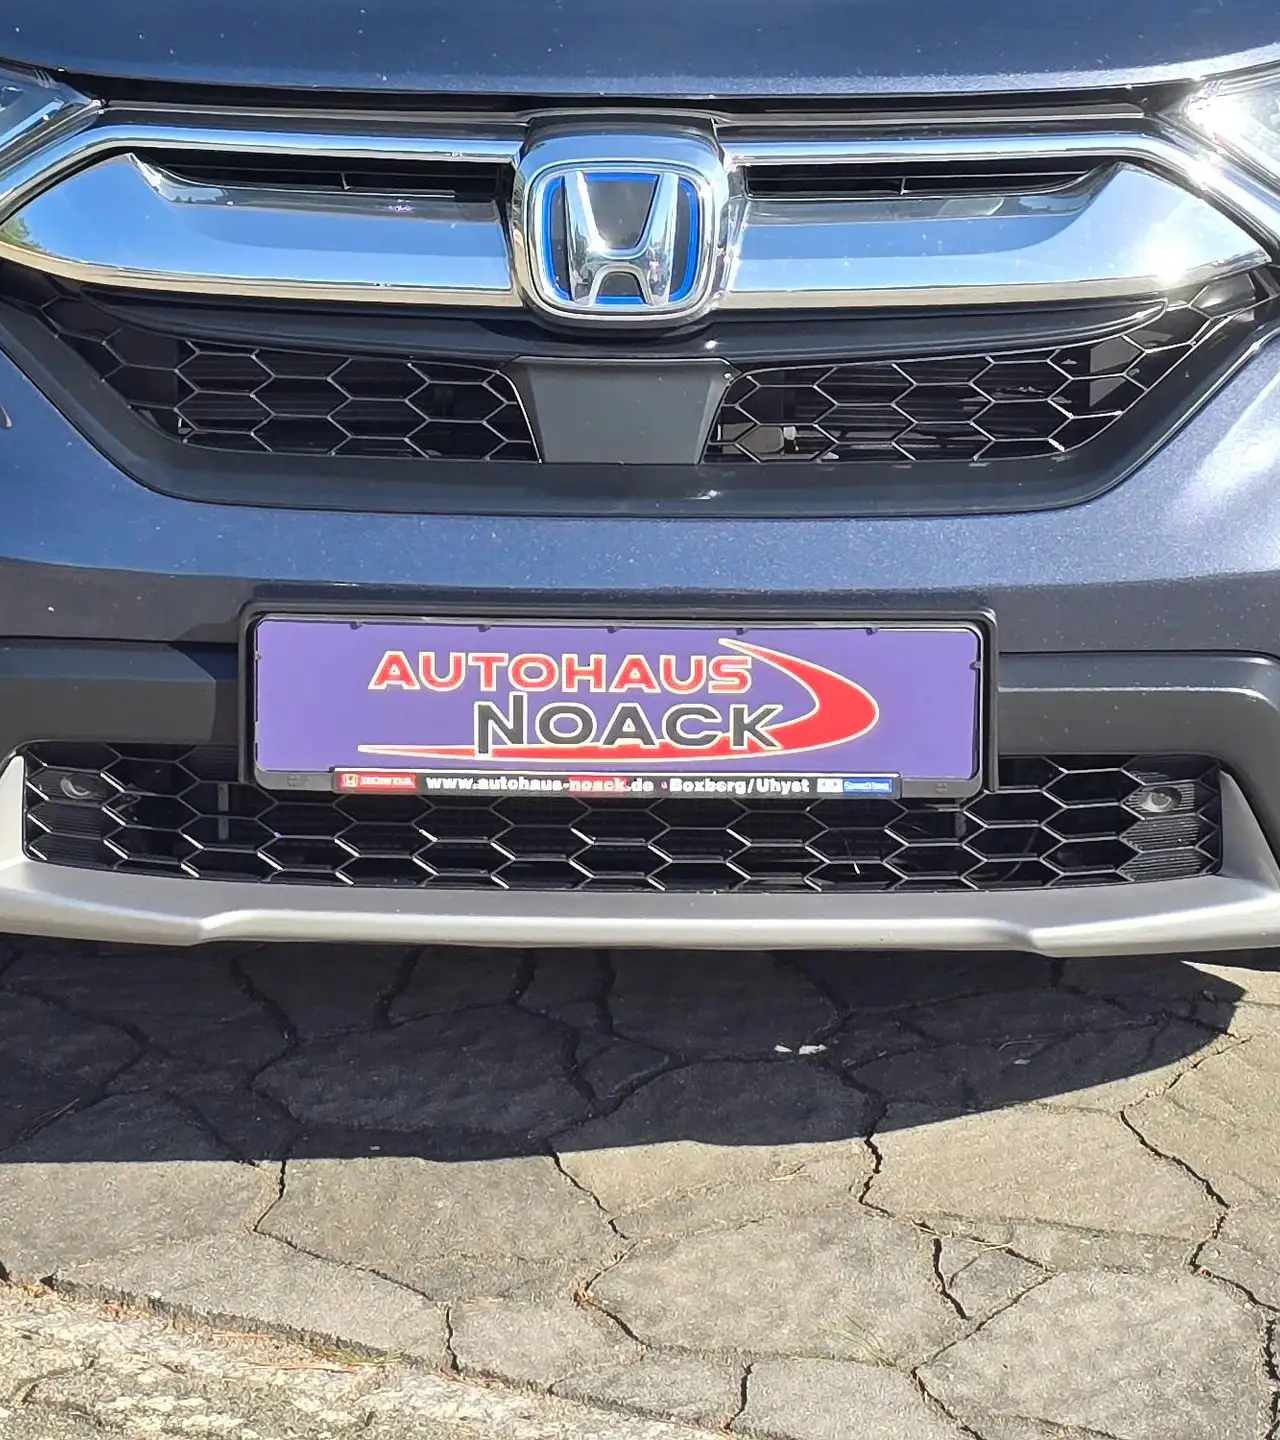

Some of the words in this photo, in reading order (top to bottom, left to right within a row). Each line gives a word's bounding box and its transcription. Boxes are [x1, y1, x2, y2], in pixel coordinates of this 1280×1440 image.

[368, 650, 753, 694] AUTOHAUS
[474, 691, 783, 759] NOACK
[426, 776, 655, 791] www.autohaus-noack.de
[669, 777, 810, 794] Boxberg/Uhyst
